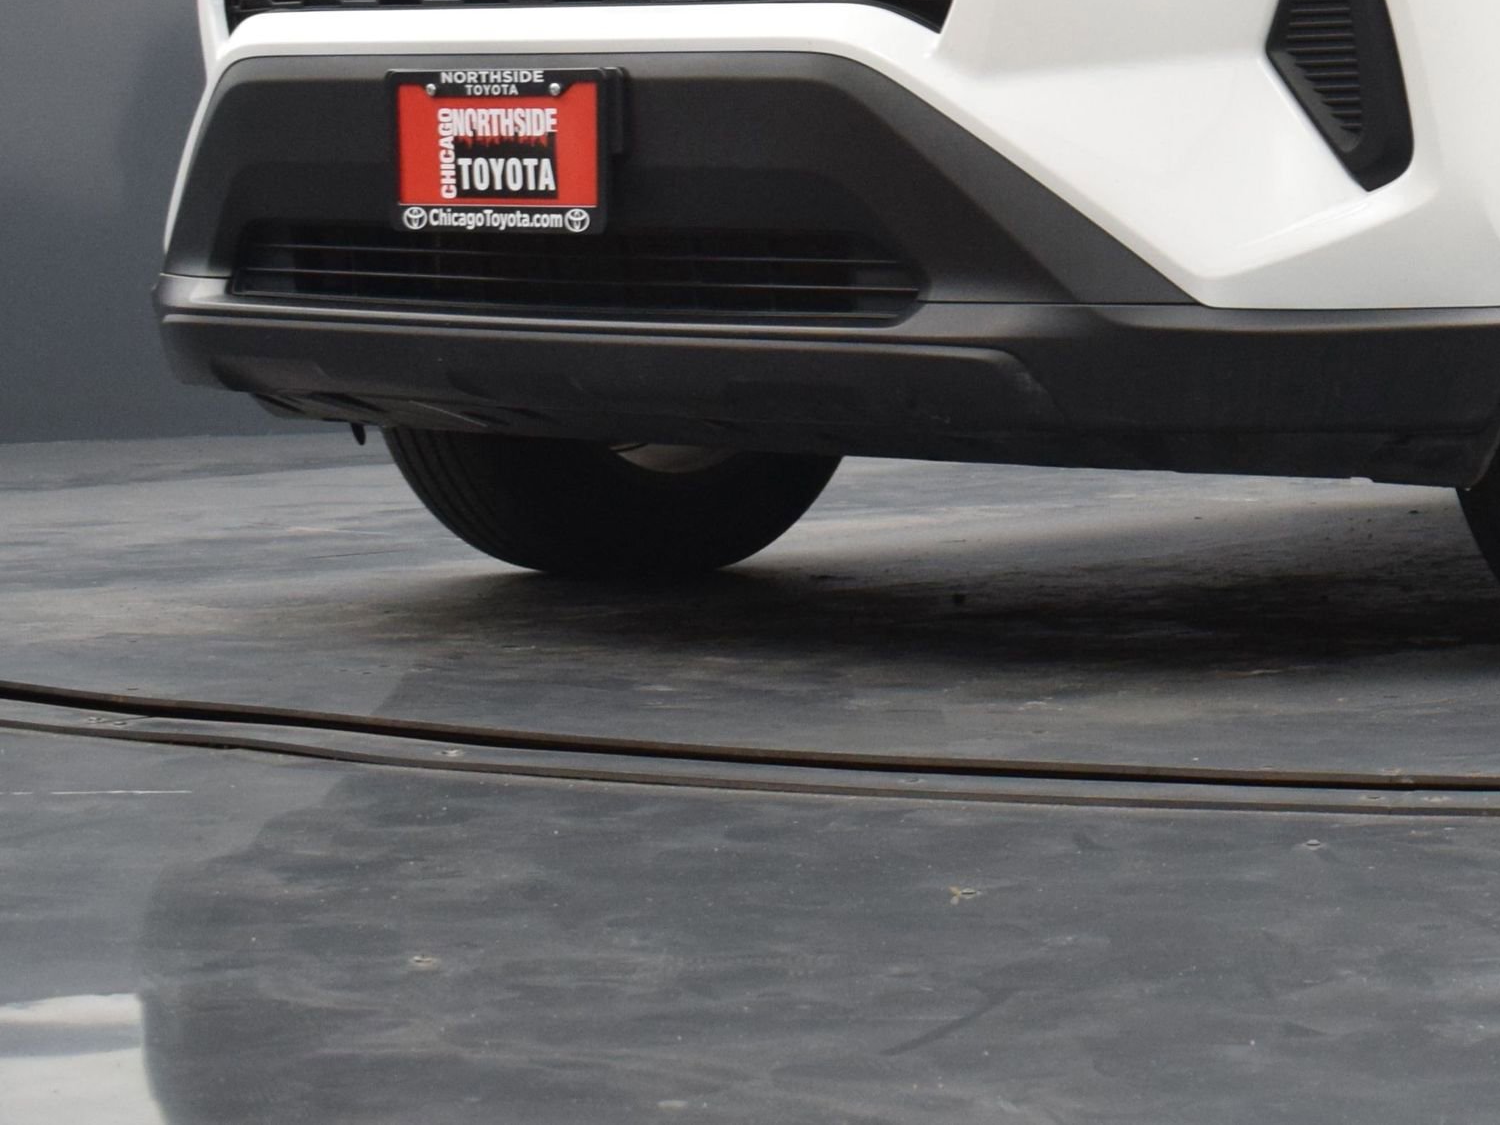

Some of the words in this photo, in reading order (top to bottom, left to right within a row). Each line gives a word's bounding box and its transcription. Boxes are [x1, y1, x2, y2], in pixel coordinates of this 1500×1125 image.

[440, 70, 545, 84] NORTHSIDE
[465, 84, 519, 96] TOYOTA
[450, 108, 558, 137] NORTHSIDE
[437, 107, 458, 199] CHICAGO
[457, 157, 556, 191] TOYOTA
[428, 208, 564, 230] ChicagoToyota.com
